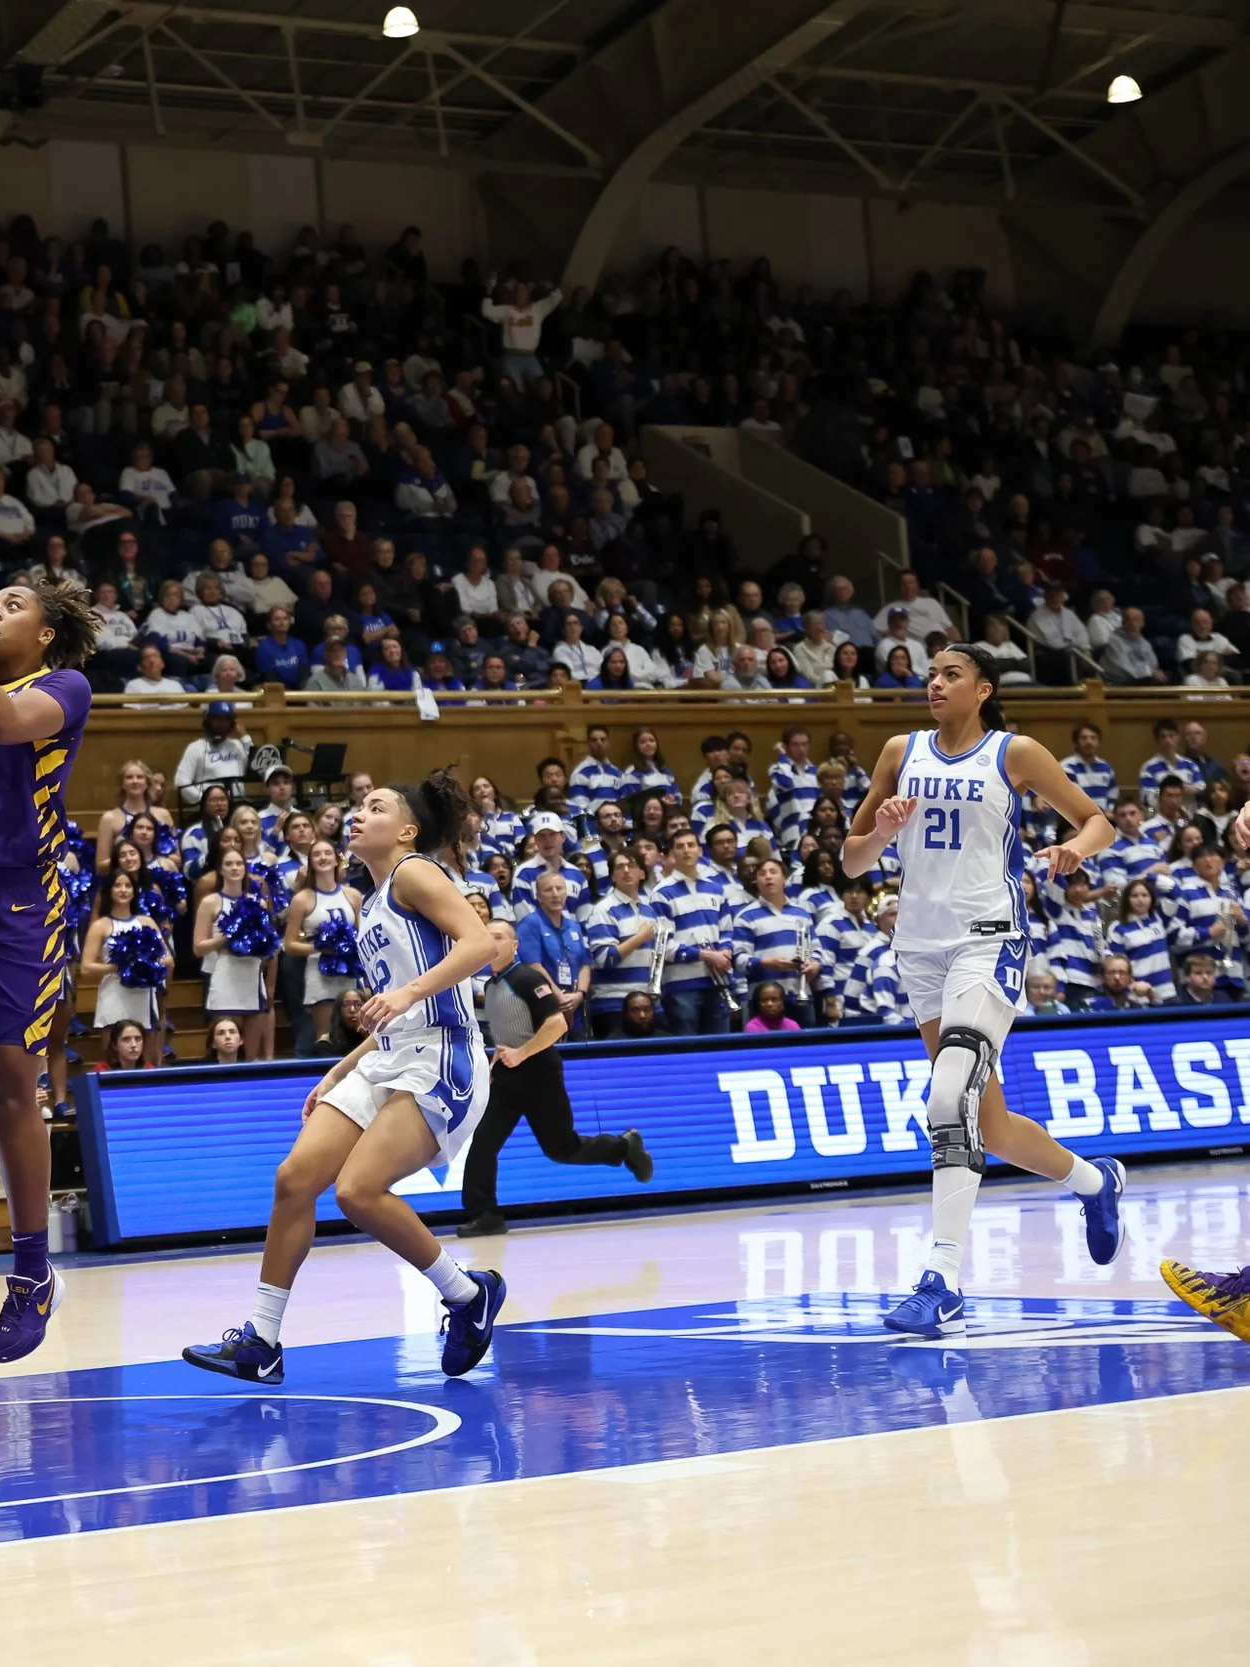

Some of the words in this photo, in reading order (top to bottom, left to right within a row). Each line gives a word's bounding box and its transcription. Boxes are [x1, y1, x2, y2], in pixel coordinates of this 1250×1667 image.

[907, 777, 985, 802] DUKE
[924, 807, 962, 850] 21
[358, 923, 391, 962] UKE
[1004, 966, 1022, 990] D
[717, 1057, 933, 1164] DUK
[10, 1283, 30, 1294] LSU
